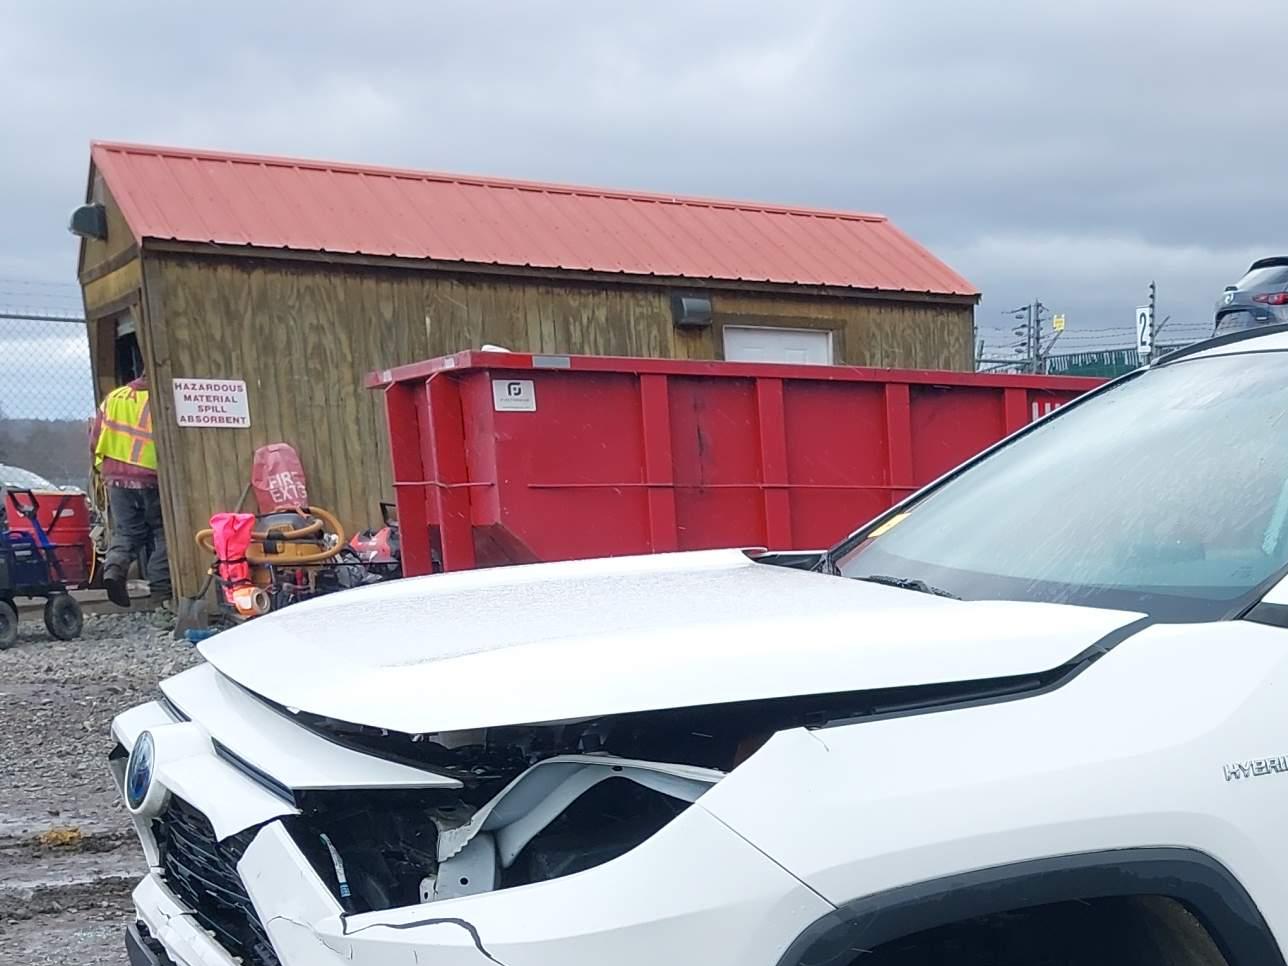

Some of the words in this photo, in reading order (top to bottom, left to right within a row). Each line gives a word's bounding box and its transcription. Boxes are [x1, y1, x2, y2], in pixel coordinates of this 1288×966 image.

[1139, 312, 1147, 346] 2
[175, 383, 244, 392] HAZARDOUS
[184, 395, 238, 403] MATERIAL
[198, 405, 227, 413] SPILL
[180, 416, 246, 424] ABSORBENT
